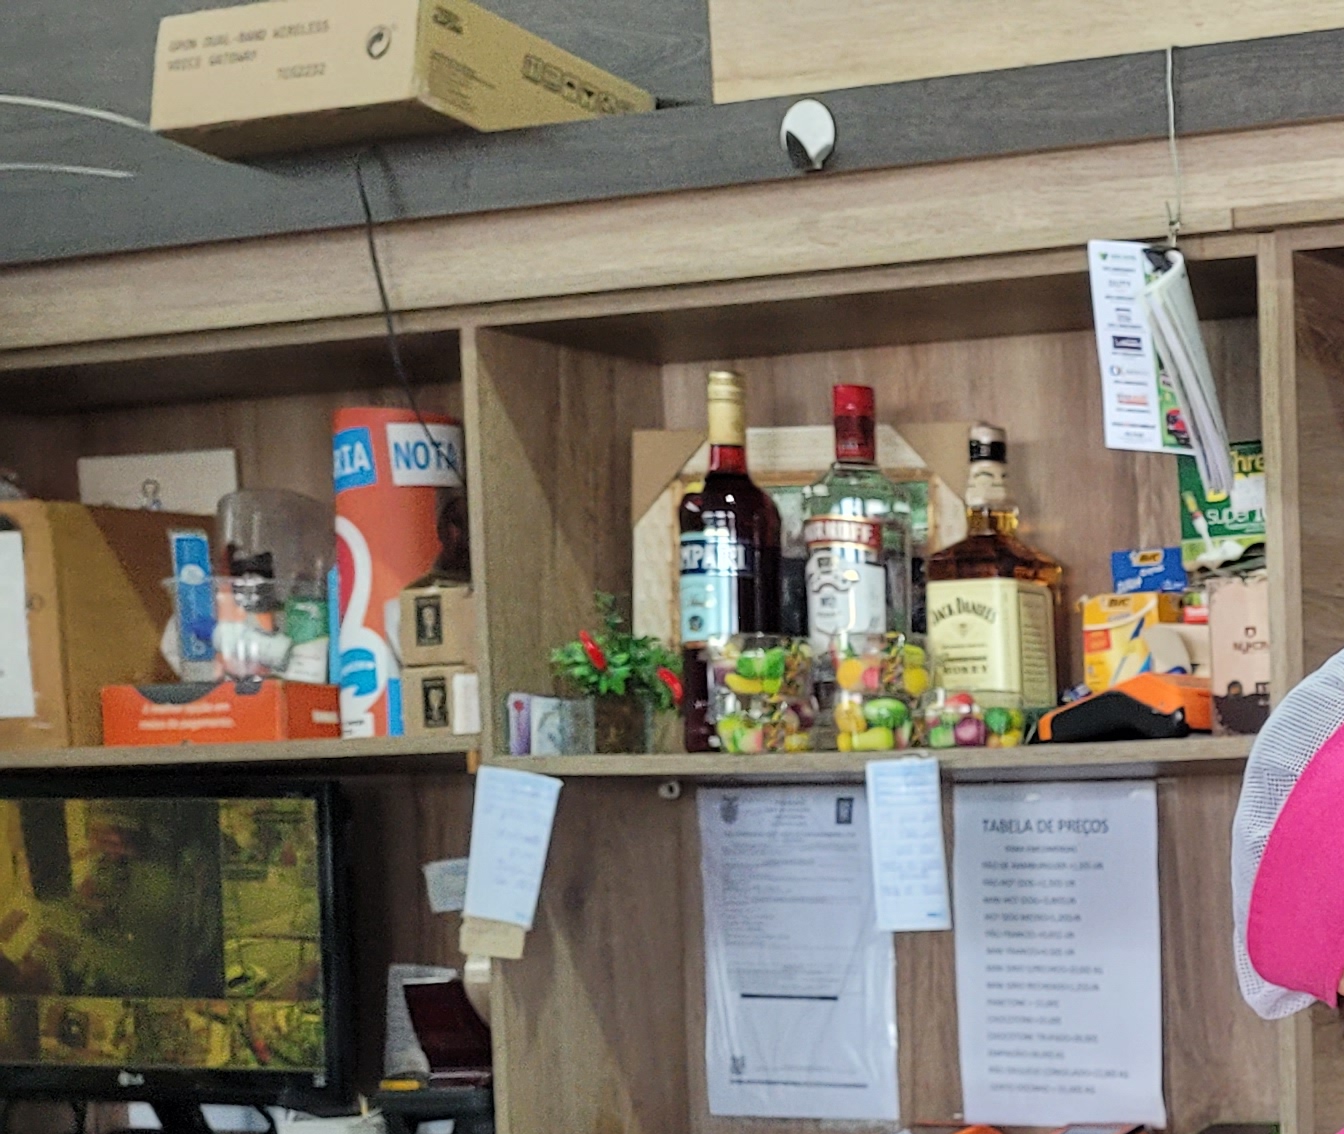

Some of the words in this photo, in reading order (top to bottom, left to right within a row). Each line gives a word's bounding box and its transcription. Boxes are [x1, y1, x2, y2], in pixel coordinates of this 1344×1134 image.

[393, 440, 458, 470] NOTA
[982, 818, 1033, 834] TABELA
[1036, 818, 1055, 834] DE
[1057, 818, 1110, 837] PREÇOS
